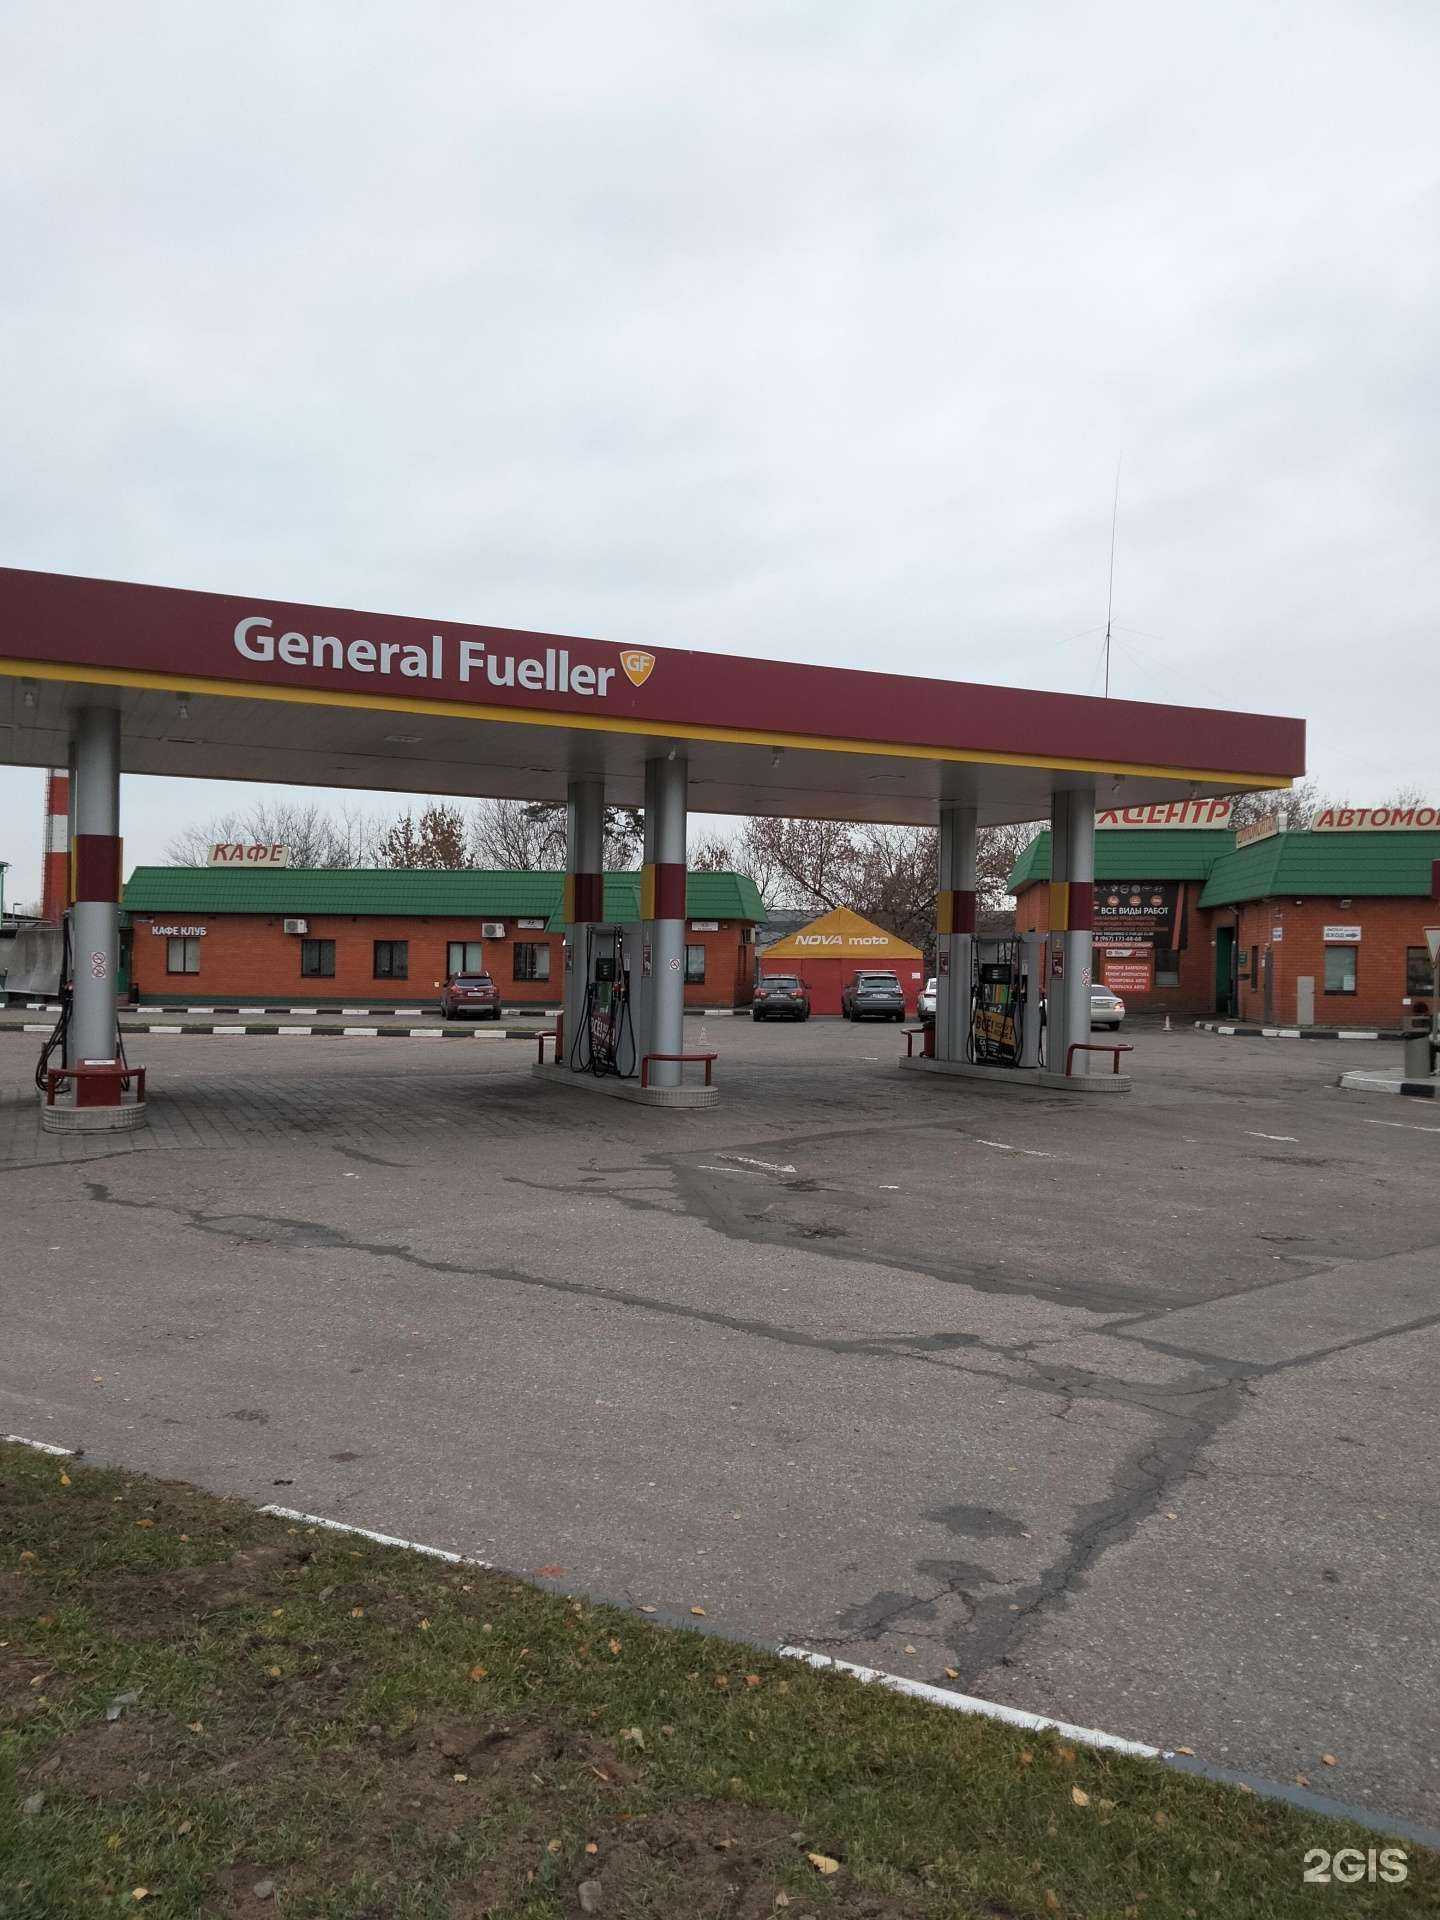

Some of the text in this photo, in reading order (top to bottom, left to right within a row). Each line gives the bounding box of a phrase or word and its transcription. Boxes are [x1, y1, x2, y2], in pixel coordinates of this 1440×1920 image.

[233, 616, 616, 697] General Fueller
[626, 655, 651, 672] GF
[1317, 807, 1440, 827] АВТОМО
[213, 843, 284, 862] КАФЕ
[1101, 907, 1169, 916] ВСЕ ВИДЫ РАБОТ
[152, 926, 207, 936] КАФЕ КЛУБ
[795, 935, 889, 945] NOVA moto
